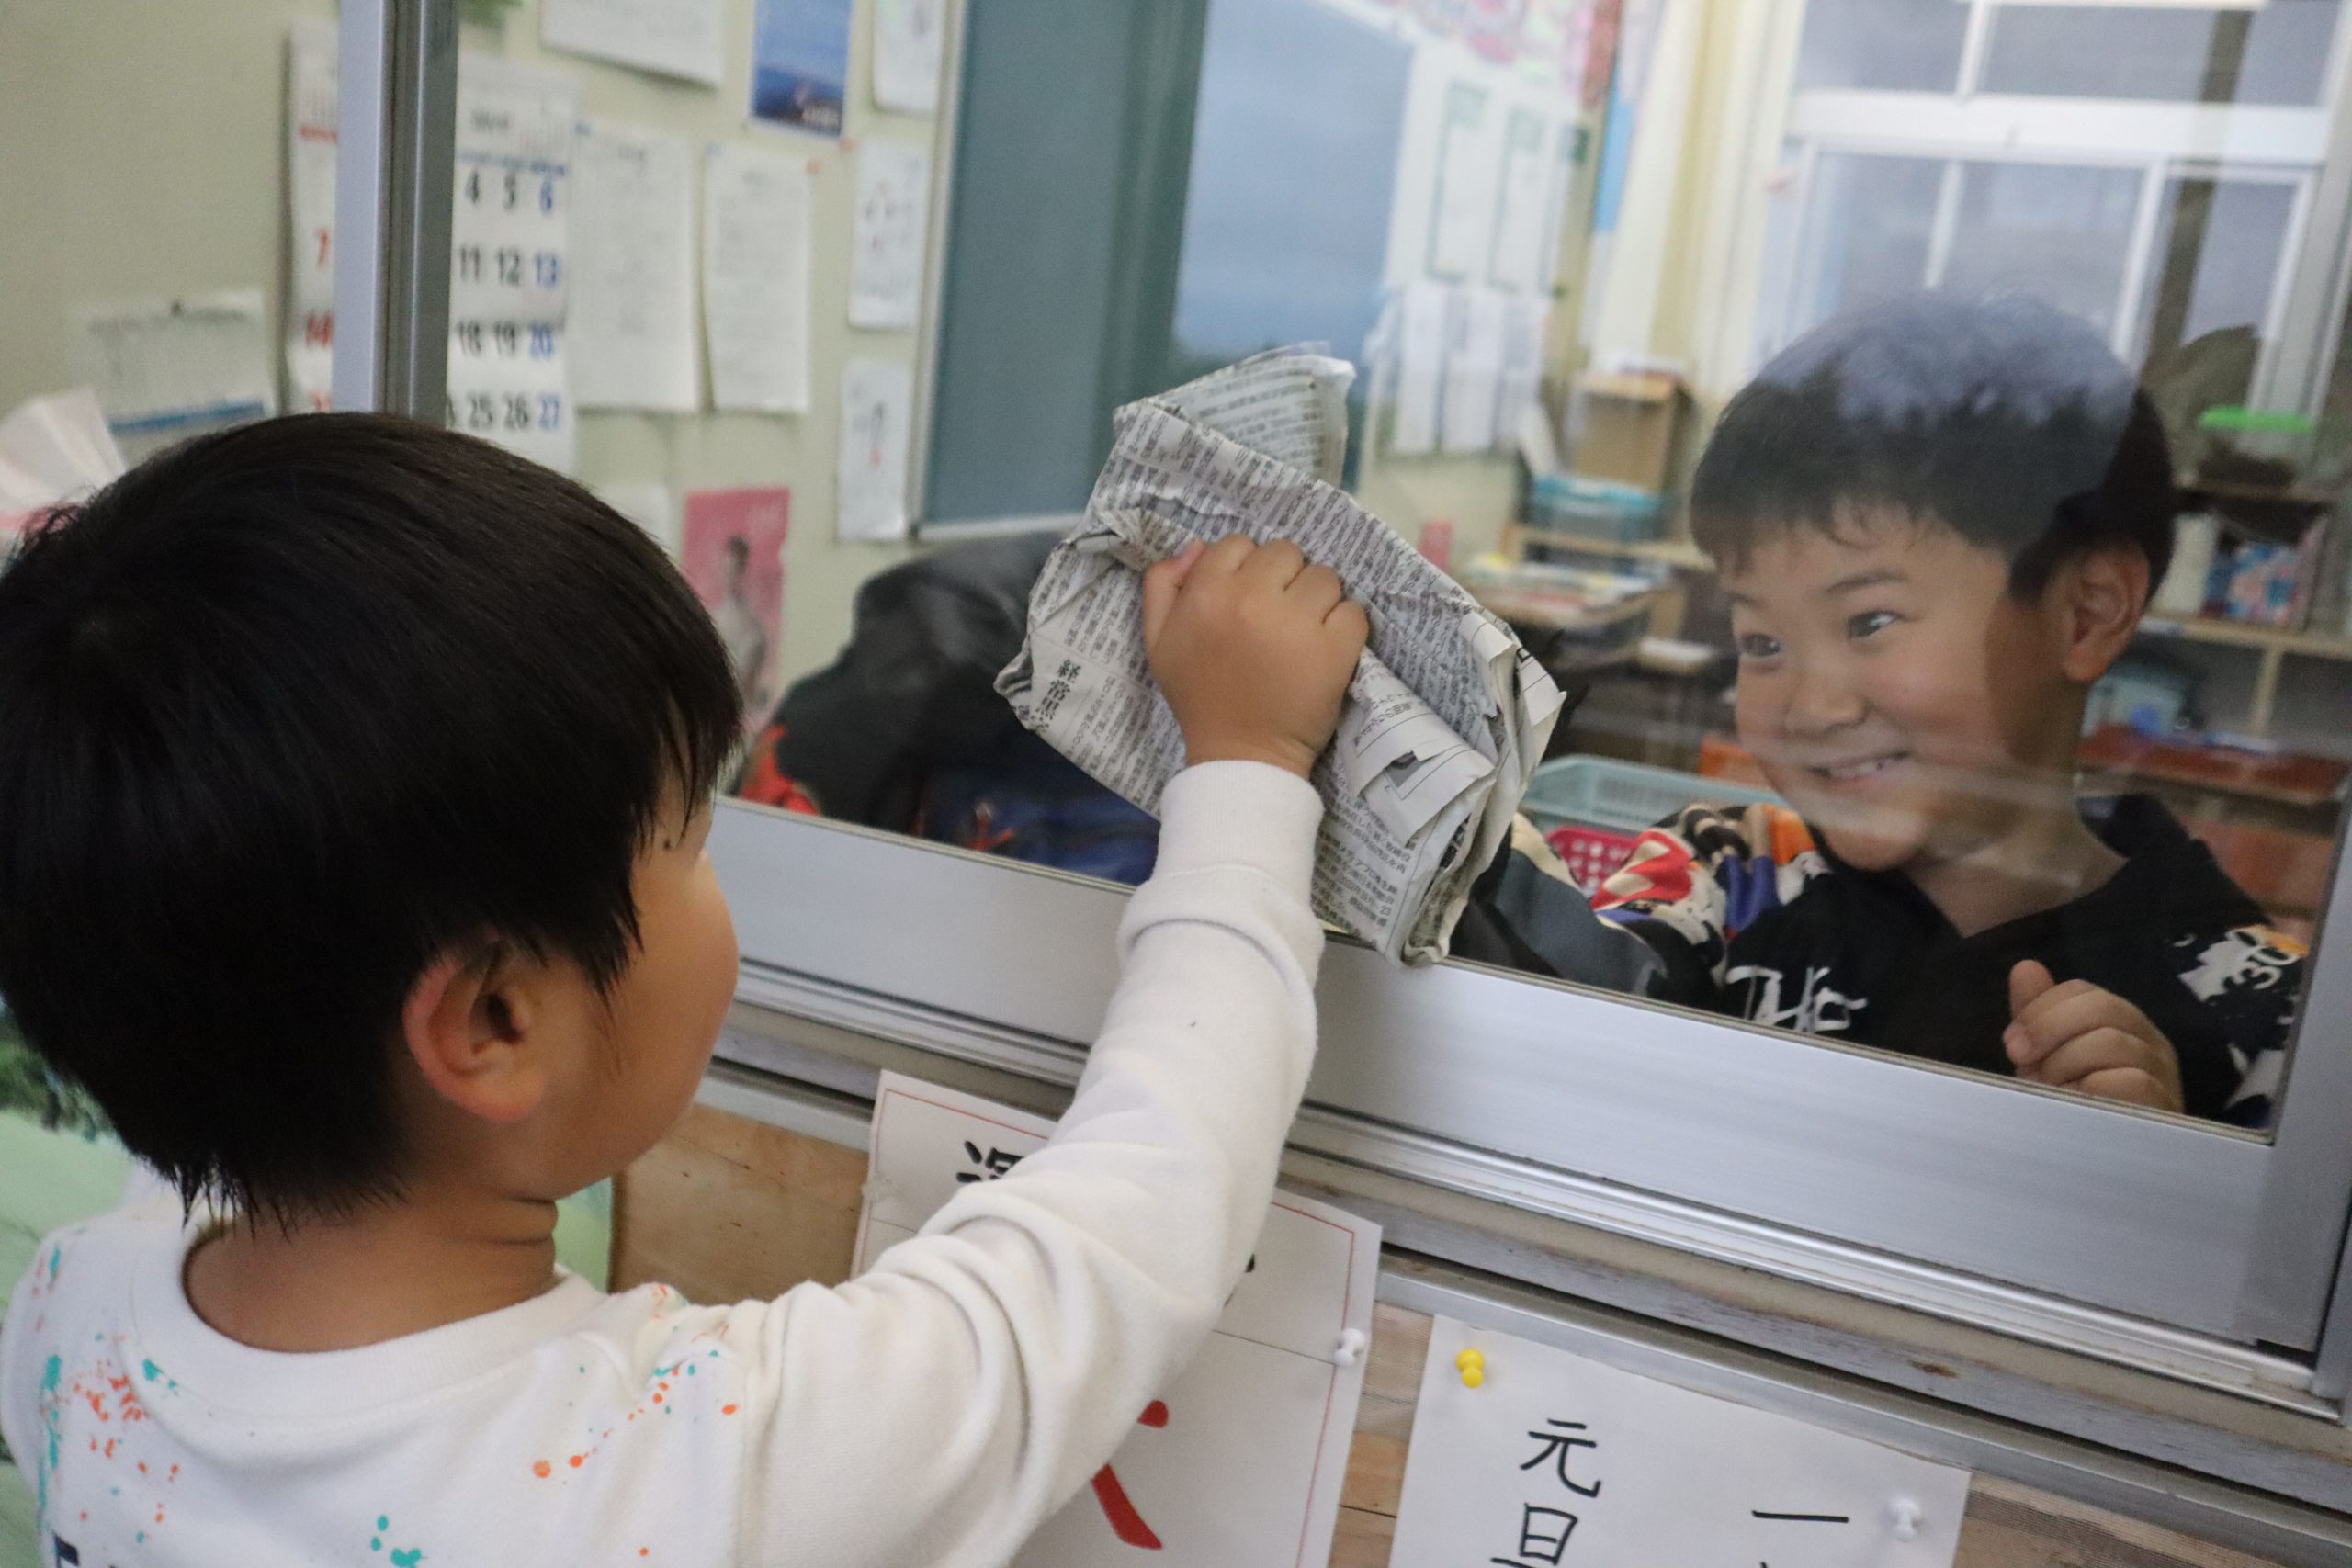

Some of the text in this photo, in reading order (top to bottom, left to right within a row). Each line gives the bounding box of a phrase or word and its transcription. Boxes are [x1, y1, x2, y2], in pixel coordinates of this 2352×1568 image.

[466, 169, 554, 215] 4 5 6
[316, 228, 330, 266] 7
[461, 247, 559, 288] 11 12 13
[494, 322, 517, 357] 19
[529, 323, 555, 359] 20
[467, 391, 493, 430] 25
[503, 392, 529, 431] 26
[538, 394, 560, 432] 27
[1489, 1418, 1602, 1568] 元旦
